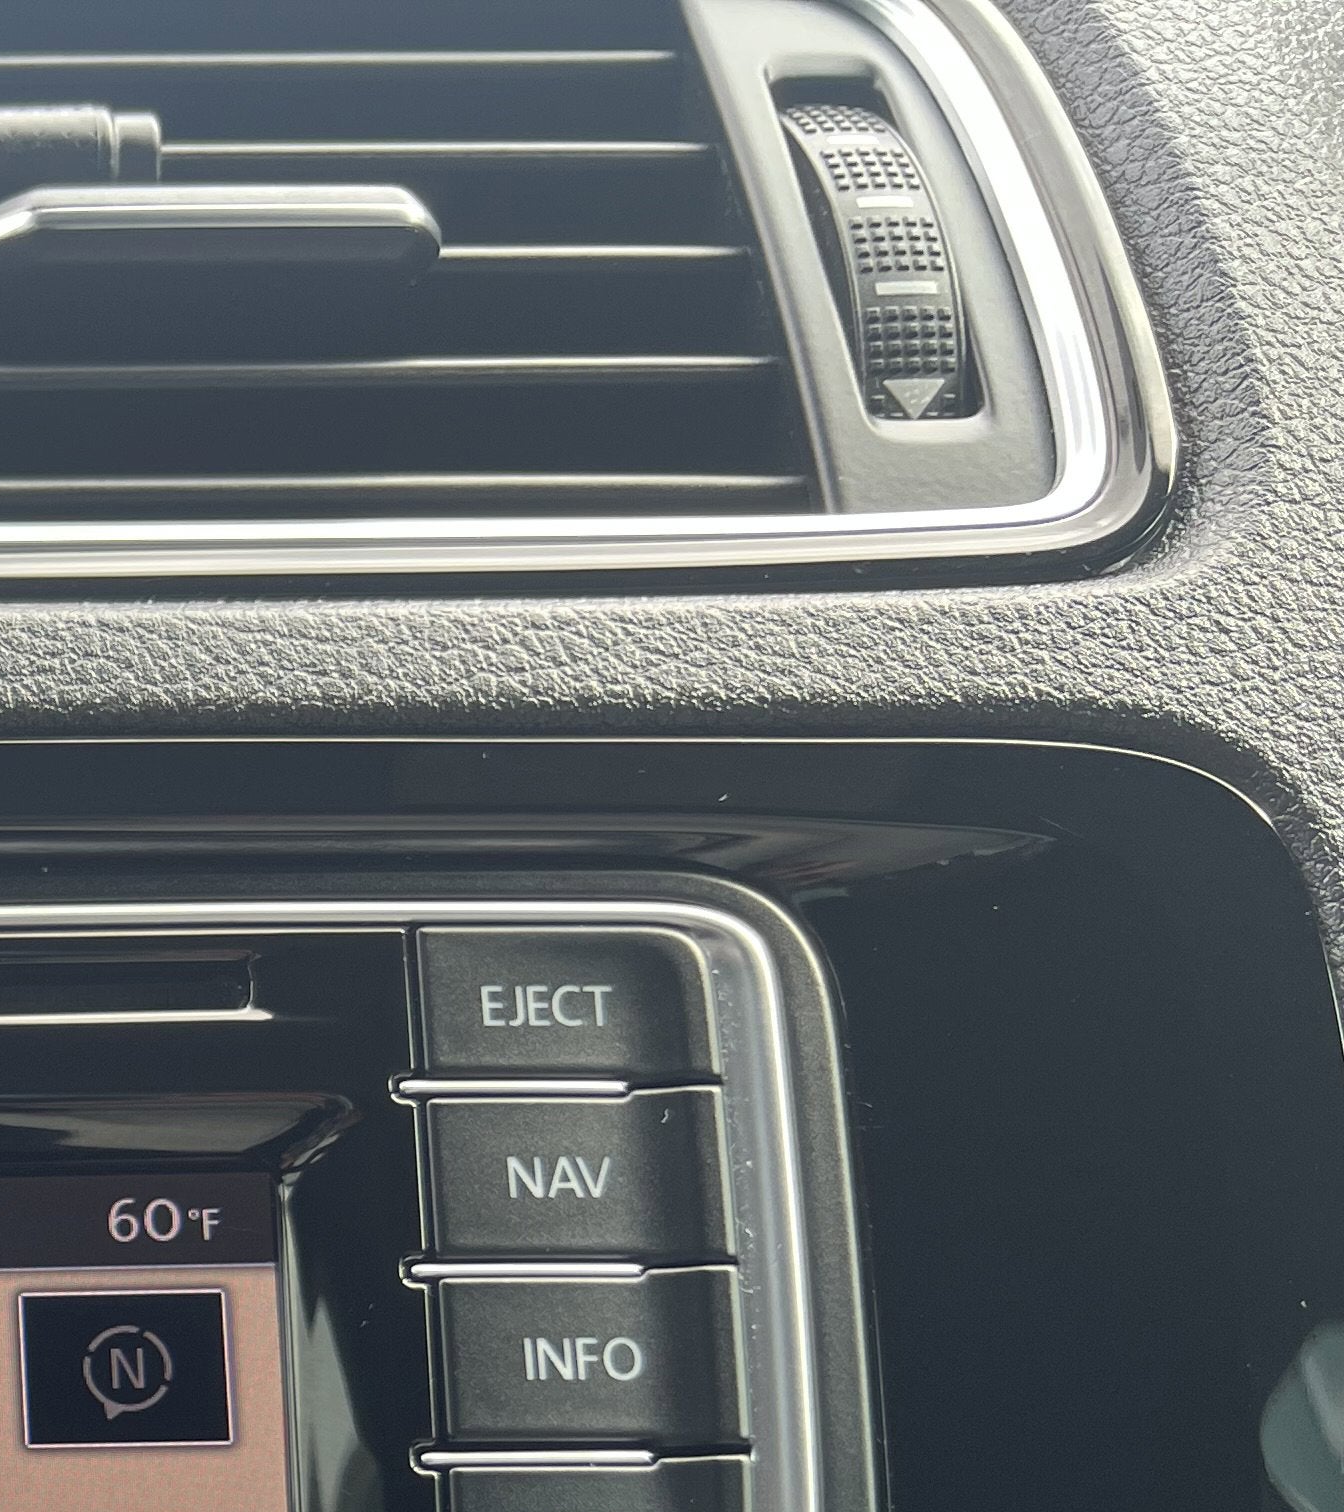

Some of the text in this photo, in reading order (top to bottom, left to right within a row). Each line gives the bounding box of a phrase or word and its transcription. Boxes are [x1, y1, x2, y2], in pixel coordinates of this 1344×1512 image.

[480, 985, 612, 1027] EJECT
[506, 1156, 611, 1199] NAV
[109, 1346, 146, 1388] N
[523, 1337, 643, 1381] INFO
